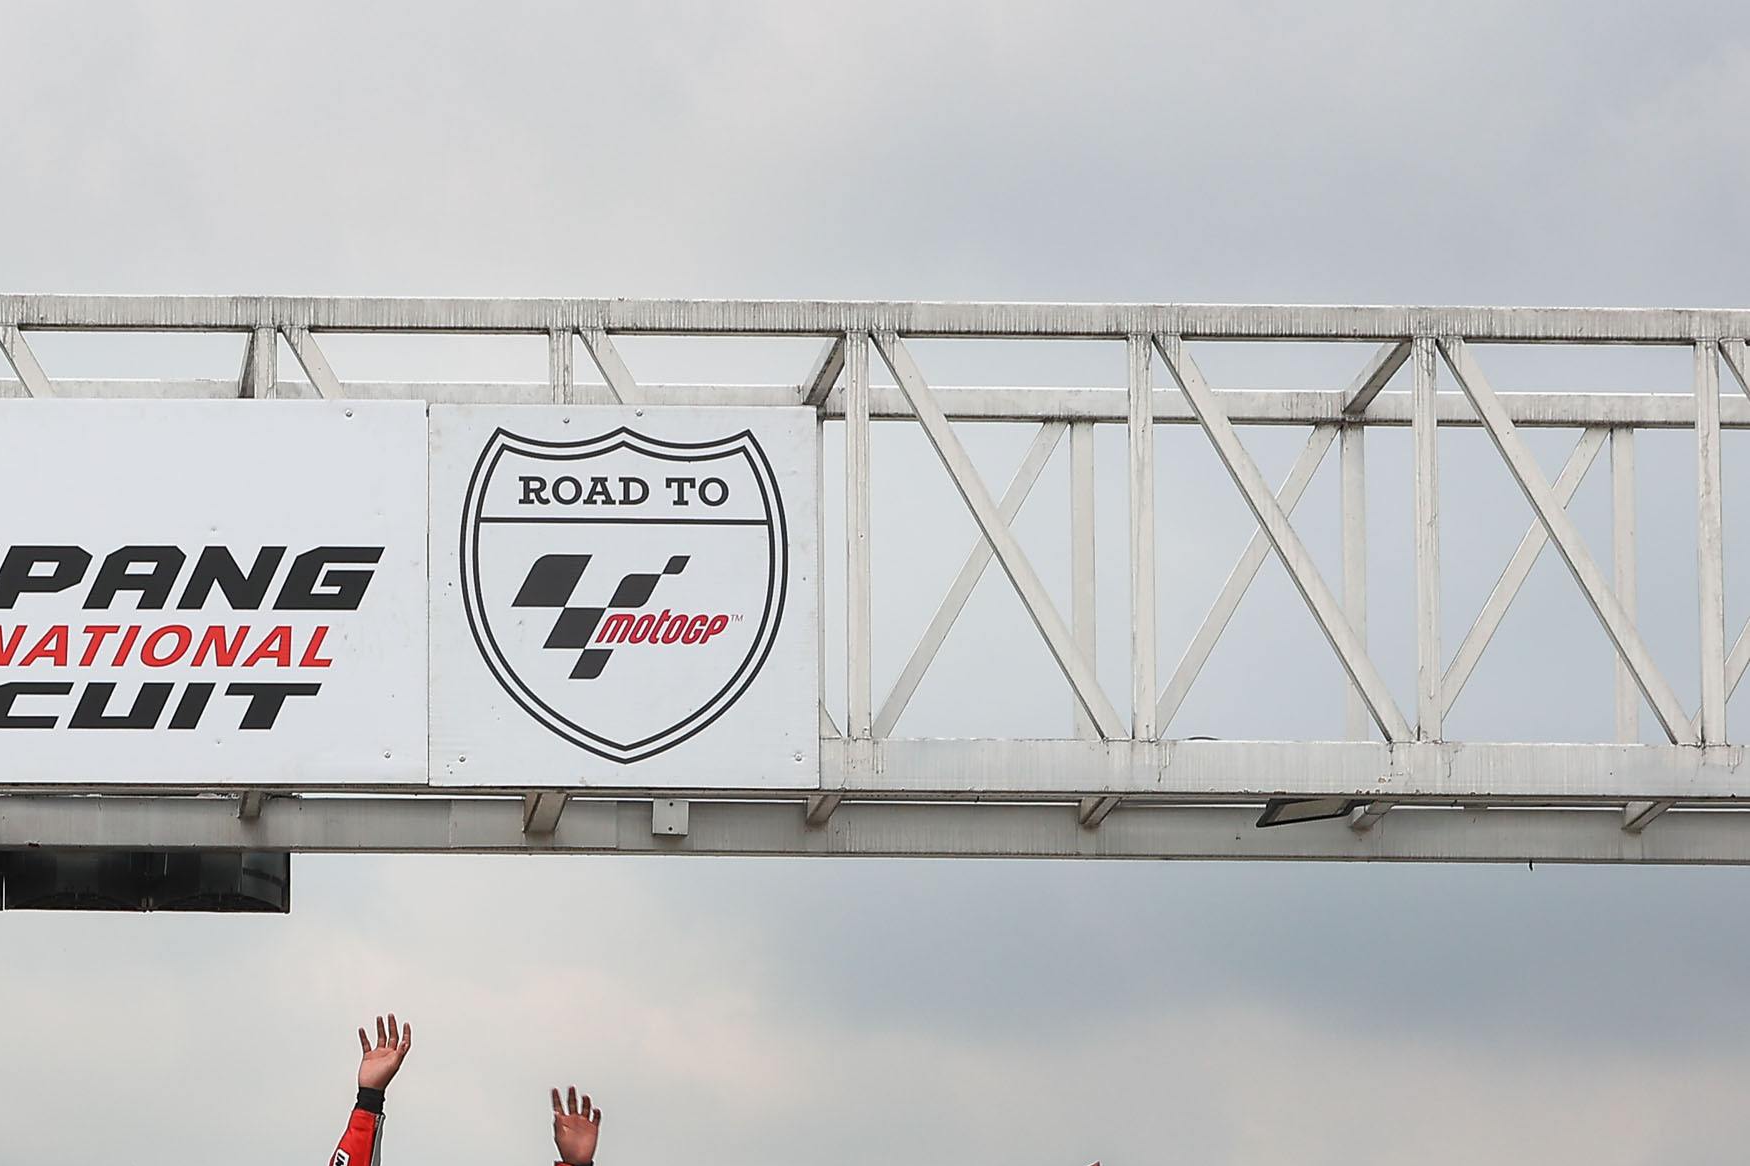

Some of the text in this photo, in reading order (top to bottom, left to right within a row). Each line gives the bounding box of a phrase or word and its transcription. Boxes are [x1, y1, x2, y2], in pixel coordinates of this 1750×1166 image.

[518, 475, 730, 507] ROAD TO
[595, 609, 729, 645] motoGP
